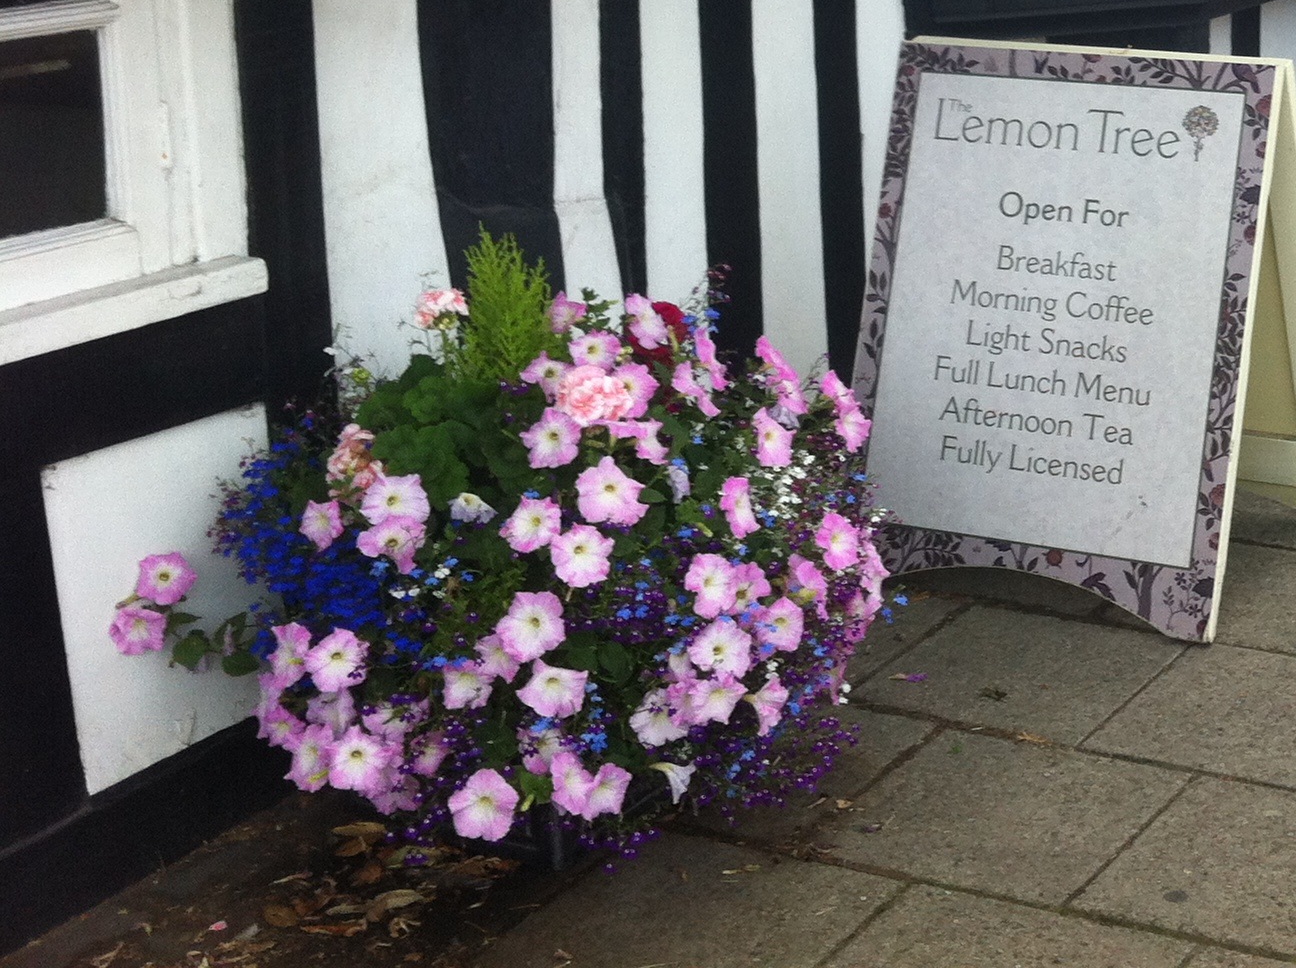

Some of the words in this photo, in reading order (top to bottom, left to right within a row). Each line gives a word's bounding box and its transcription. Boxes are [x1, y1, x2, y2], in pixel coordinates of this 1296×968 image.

[933, 97, 1080, 152] Lemon
[1086, 107, 1182, 159] Tree
[948, 98, 973, 114] The
[998, 190, 1073, 226] Open
[1081, 198, 1130, 228] For
[996, 244, 1118, 283] Breakfast
[949, 278, 1059, 322] Morning
[1065, 291, 1155, 327] Coffee
[965, 320, 1032, 356] Light
[1038, 327, 1129, 364] Snacks
[933, 354, 980, 385] Full
[986, 361, 1067, 397] Lunch
[1073, 371, 1152, 407] Menu
[938, 396, 1074, 438] Afternoon
[1081, 411, 1135, 446] Tea
[939, 434, 1003, 474] Fully
[1008, 443, 1126, 485] Licensed
